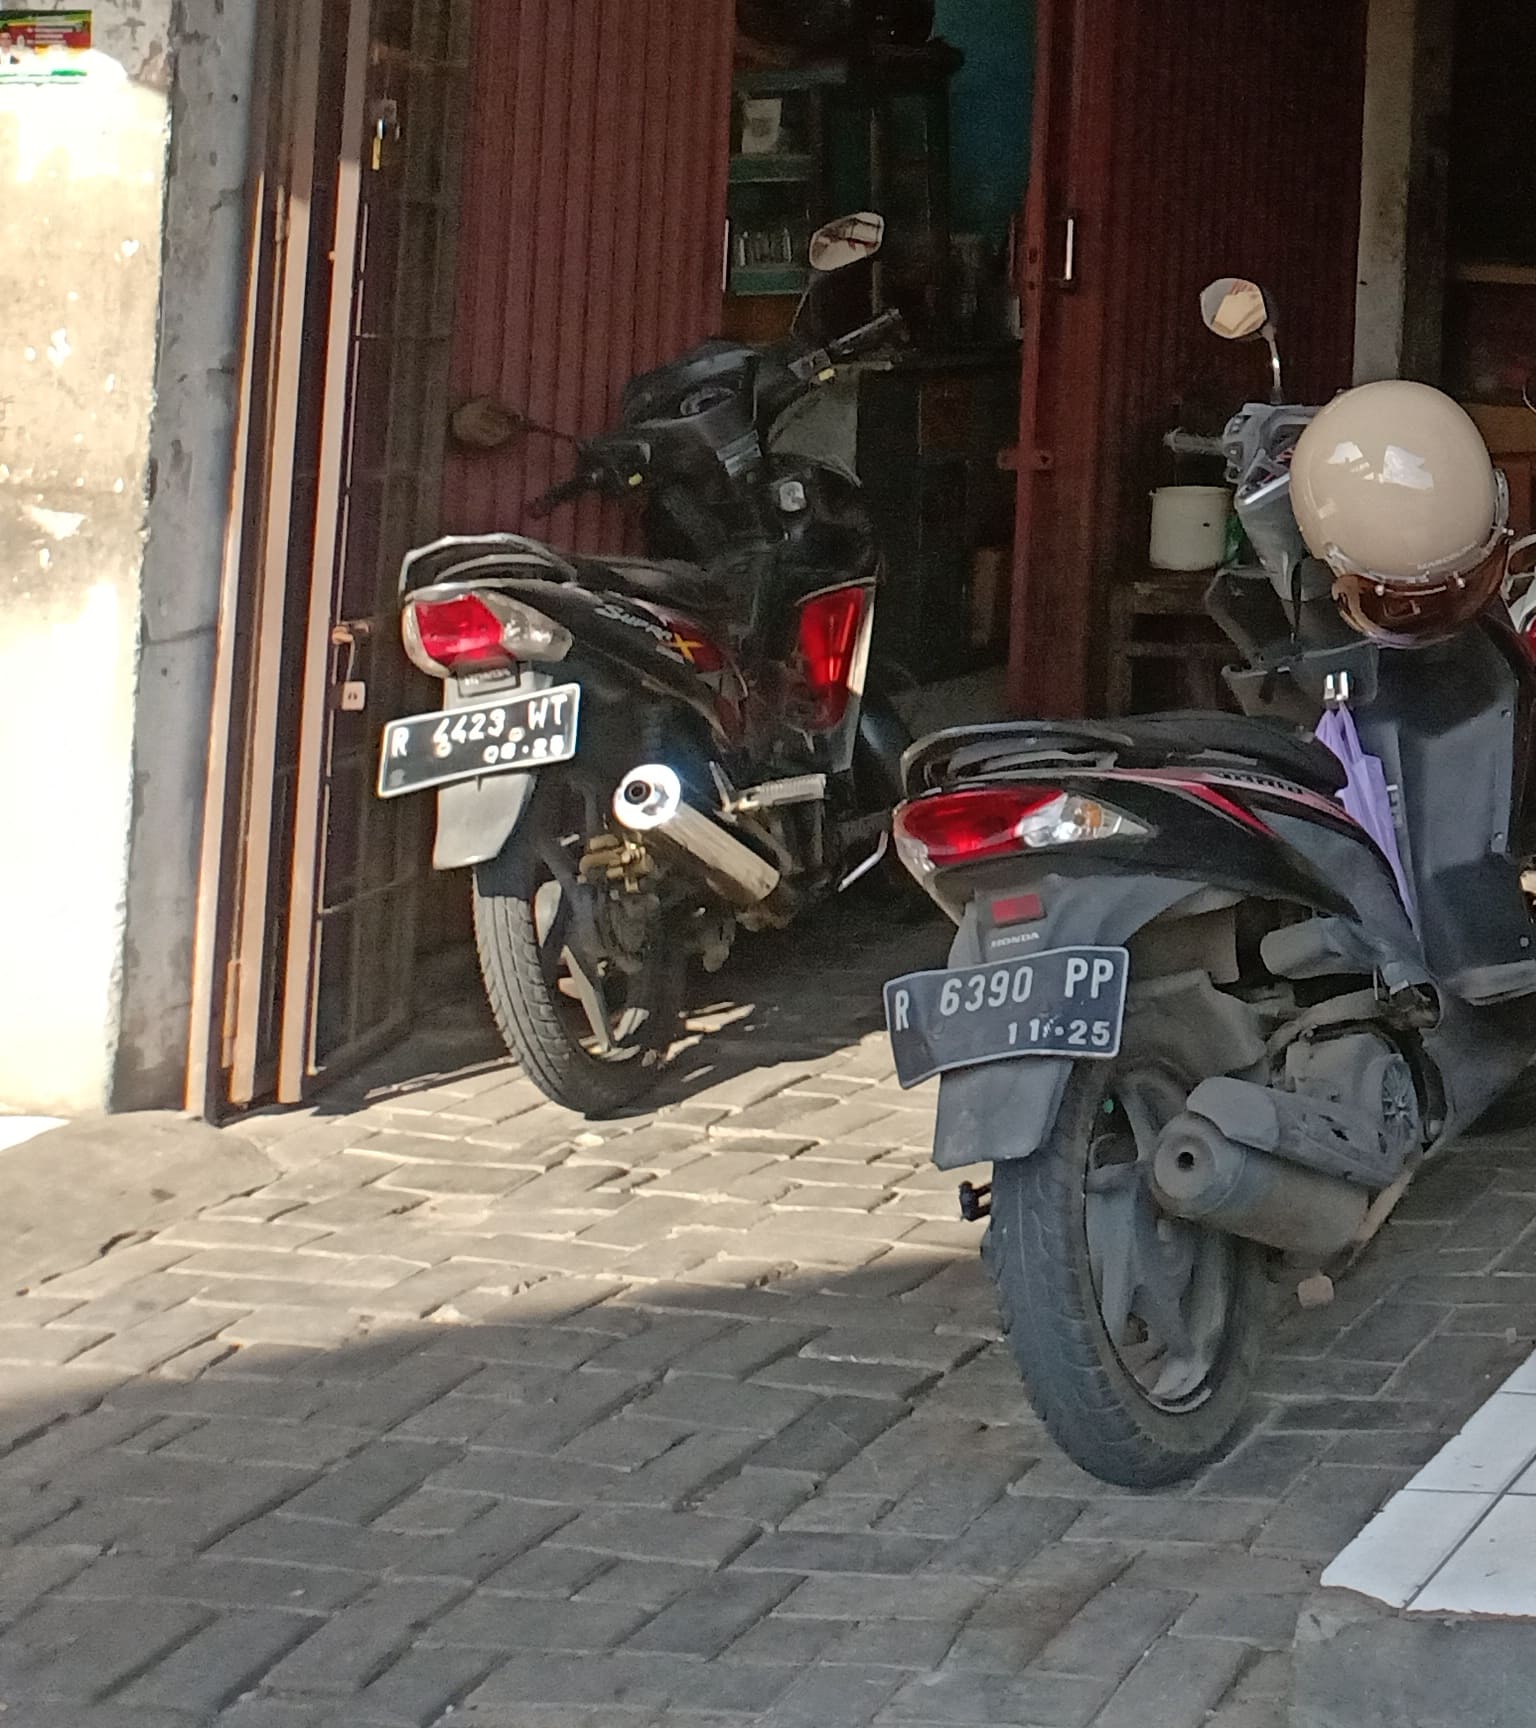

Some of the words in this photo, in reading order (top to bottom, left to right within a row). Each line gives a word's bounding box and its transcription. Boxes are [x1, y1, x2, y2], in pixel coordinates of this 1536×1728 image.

[391, 727, 410, 757] R
[528, 694, 568, 730] WT
[991, 932, 1040, 948] HONDA
[895, 989, 910, 1031] R
[940, 966, 1034, 1016] 6390
[1064, 958, 1114, 999] PP
